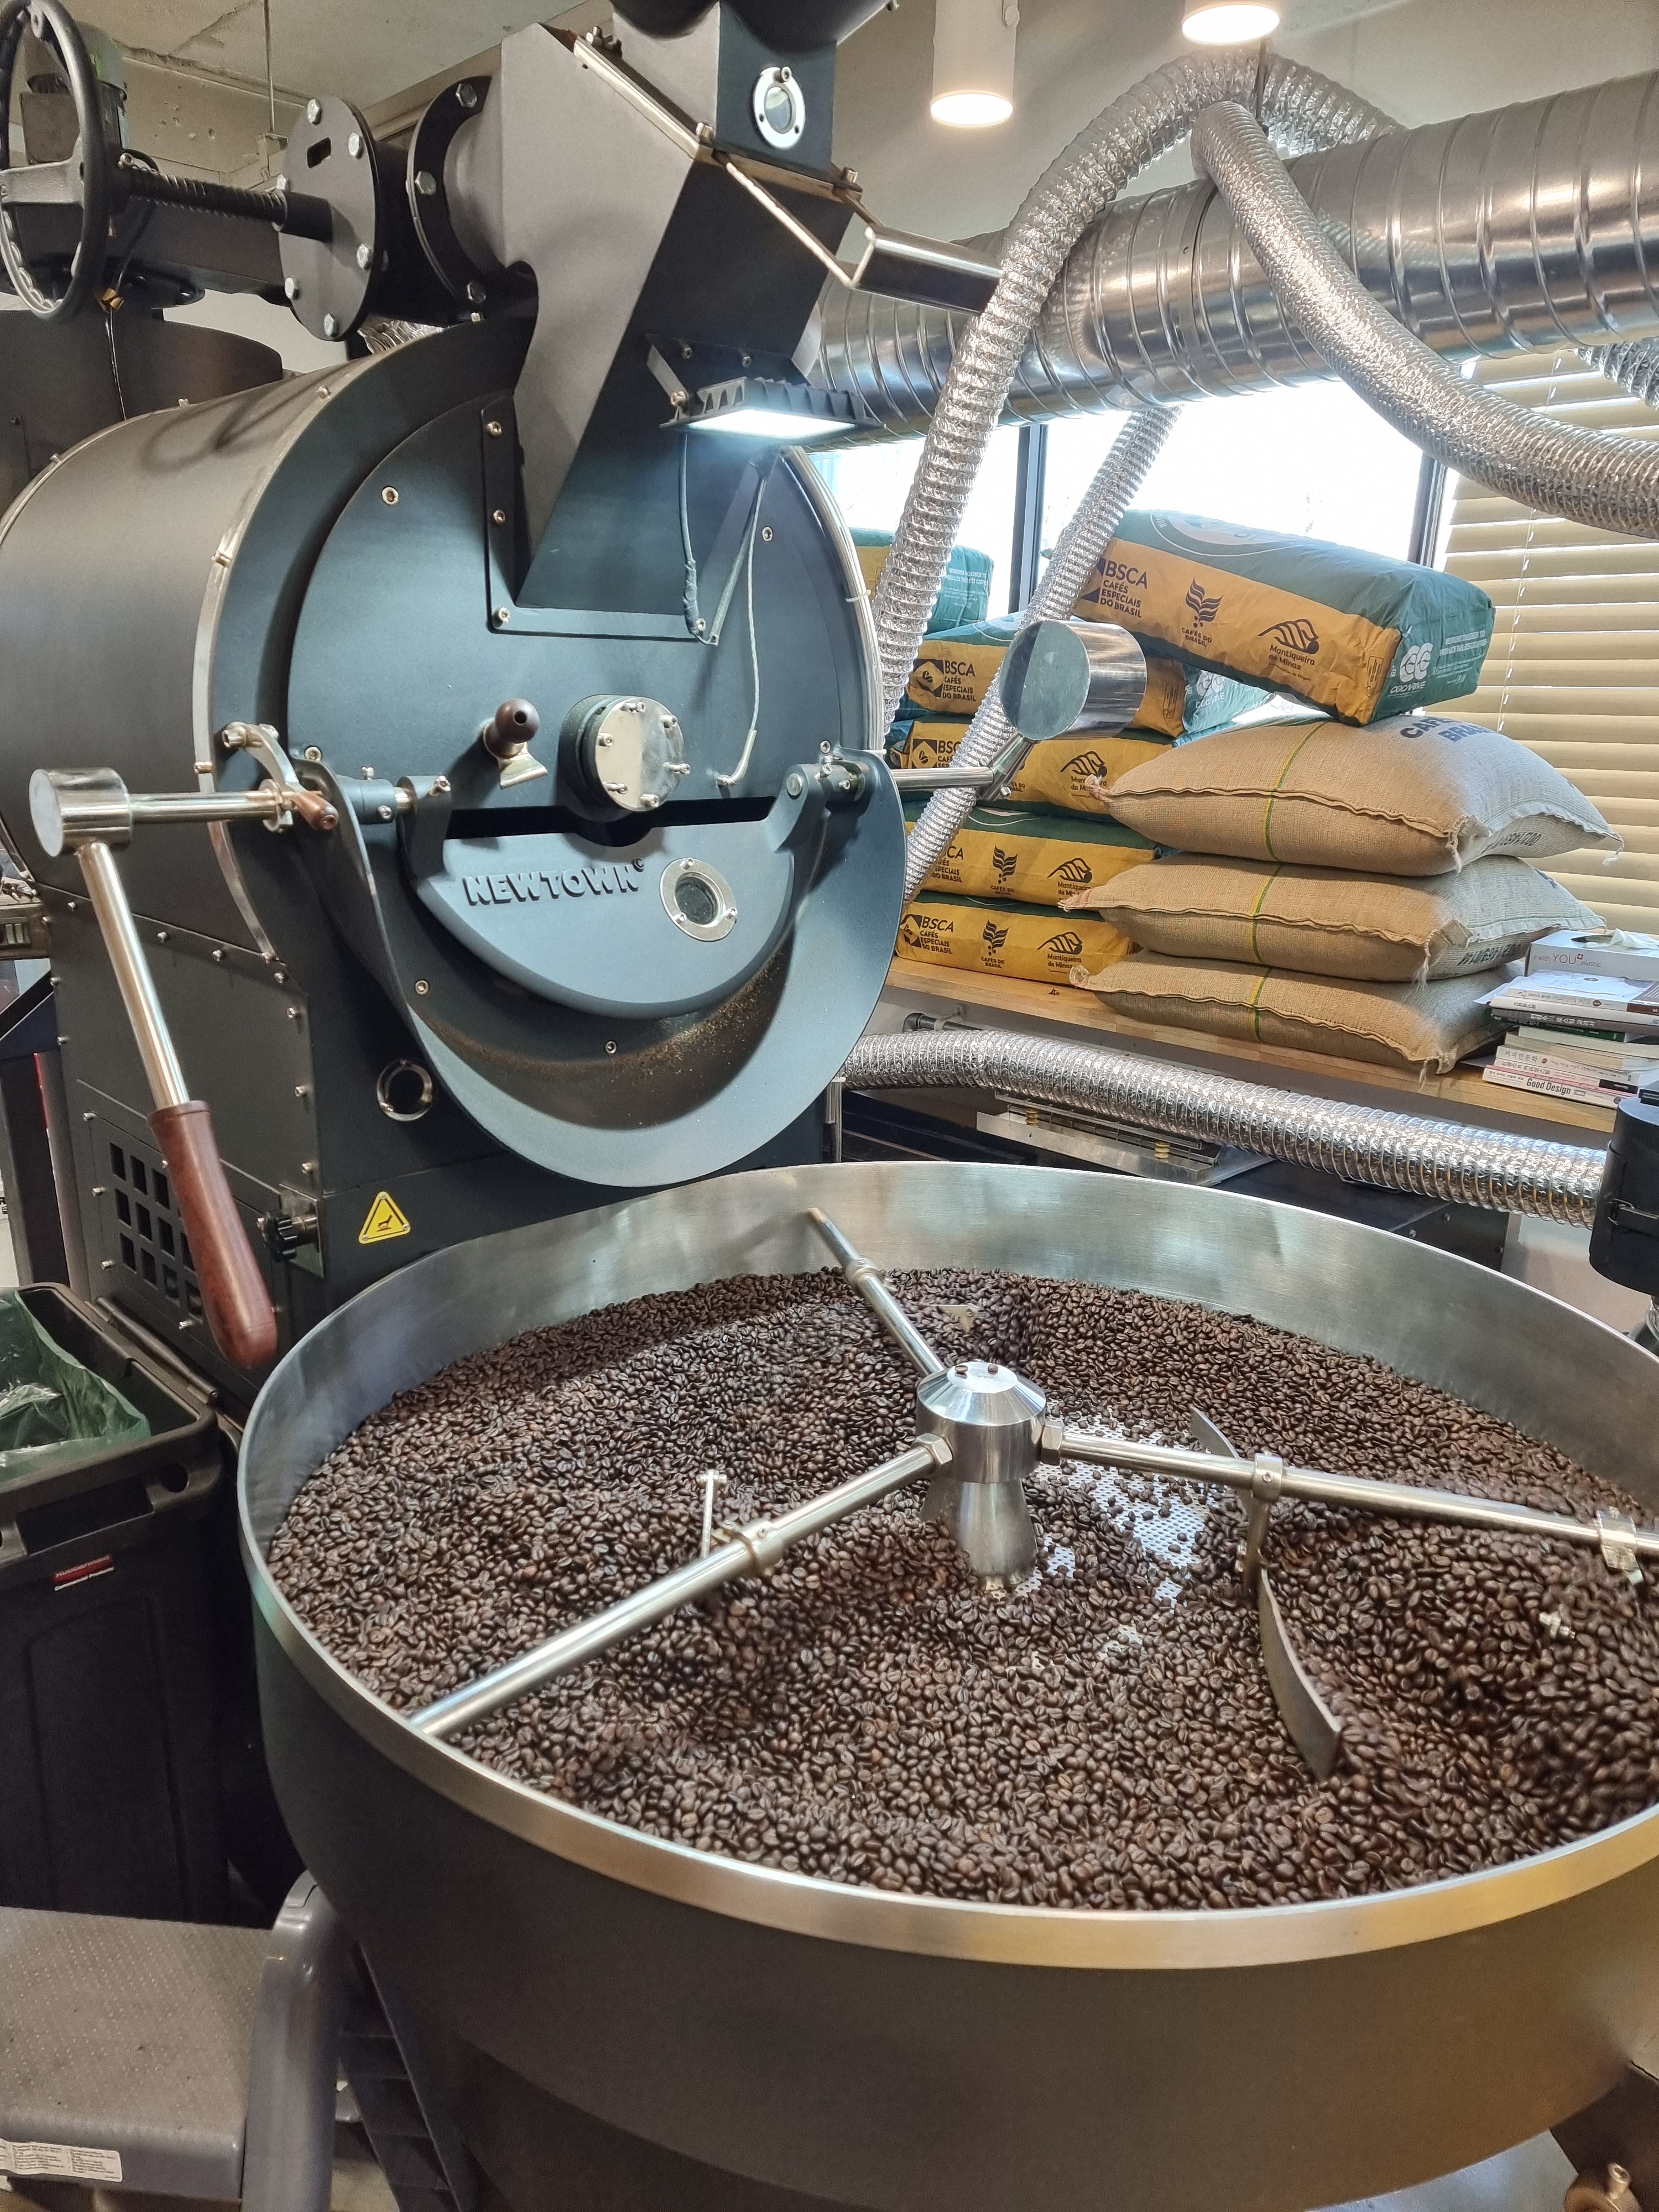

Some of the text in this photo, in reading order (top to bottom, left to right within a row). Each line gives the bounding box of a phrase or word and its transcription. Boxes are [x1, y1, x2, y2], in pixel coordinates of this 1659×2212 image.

[1105, 560, 1147, 589] BSCA
[1103, 579, 1129, 593] CAFÉS
[1102, 588, 1142, 608] ESPECIAIS
[1100, 597, 1142, 618] DO BRASIL
[1181, 627, 1212, 643] CAFÉS DO
[1185, 635, 1207, 647] BRASIL
[1270, 644, 1315, 666] Mantiqueira
[945, 660, 975, 677] BSCA
[1279, 657, 1301, 670] Minas
[944, 676, 962, 685] CAFÉS
[943, 684, 974, 694] ESPECIAIS
[953, 693, 977, 702] BRASIL
[938, 740, 961, 754] BSC
[945, 845, 964, 860] CA
[935, 866, 960, 875] PECIAIS
[942, 873, 963, 883] BRASIL
[462, 864, 639, 906] NEWTOWN
[922, 916, 954, 932] BSCA
[920, 930, 938, 938] CAFÉS
[920, 937, 950, 947] ESPECIAIS
[931, 944, 953, 954] BRASIL
[1047, 953, 1082, 963] Mantiqueira
[1552, 953, 1577, 964] YOU
[1526, 1078, 1572, 1095] Good Design
